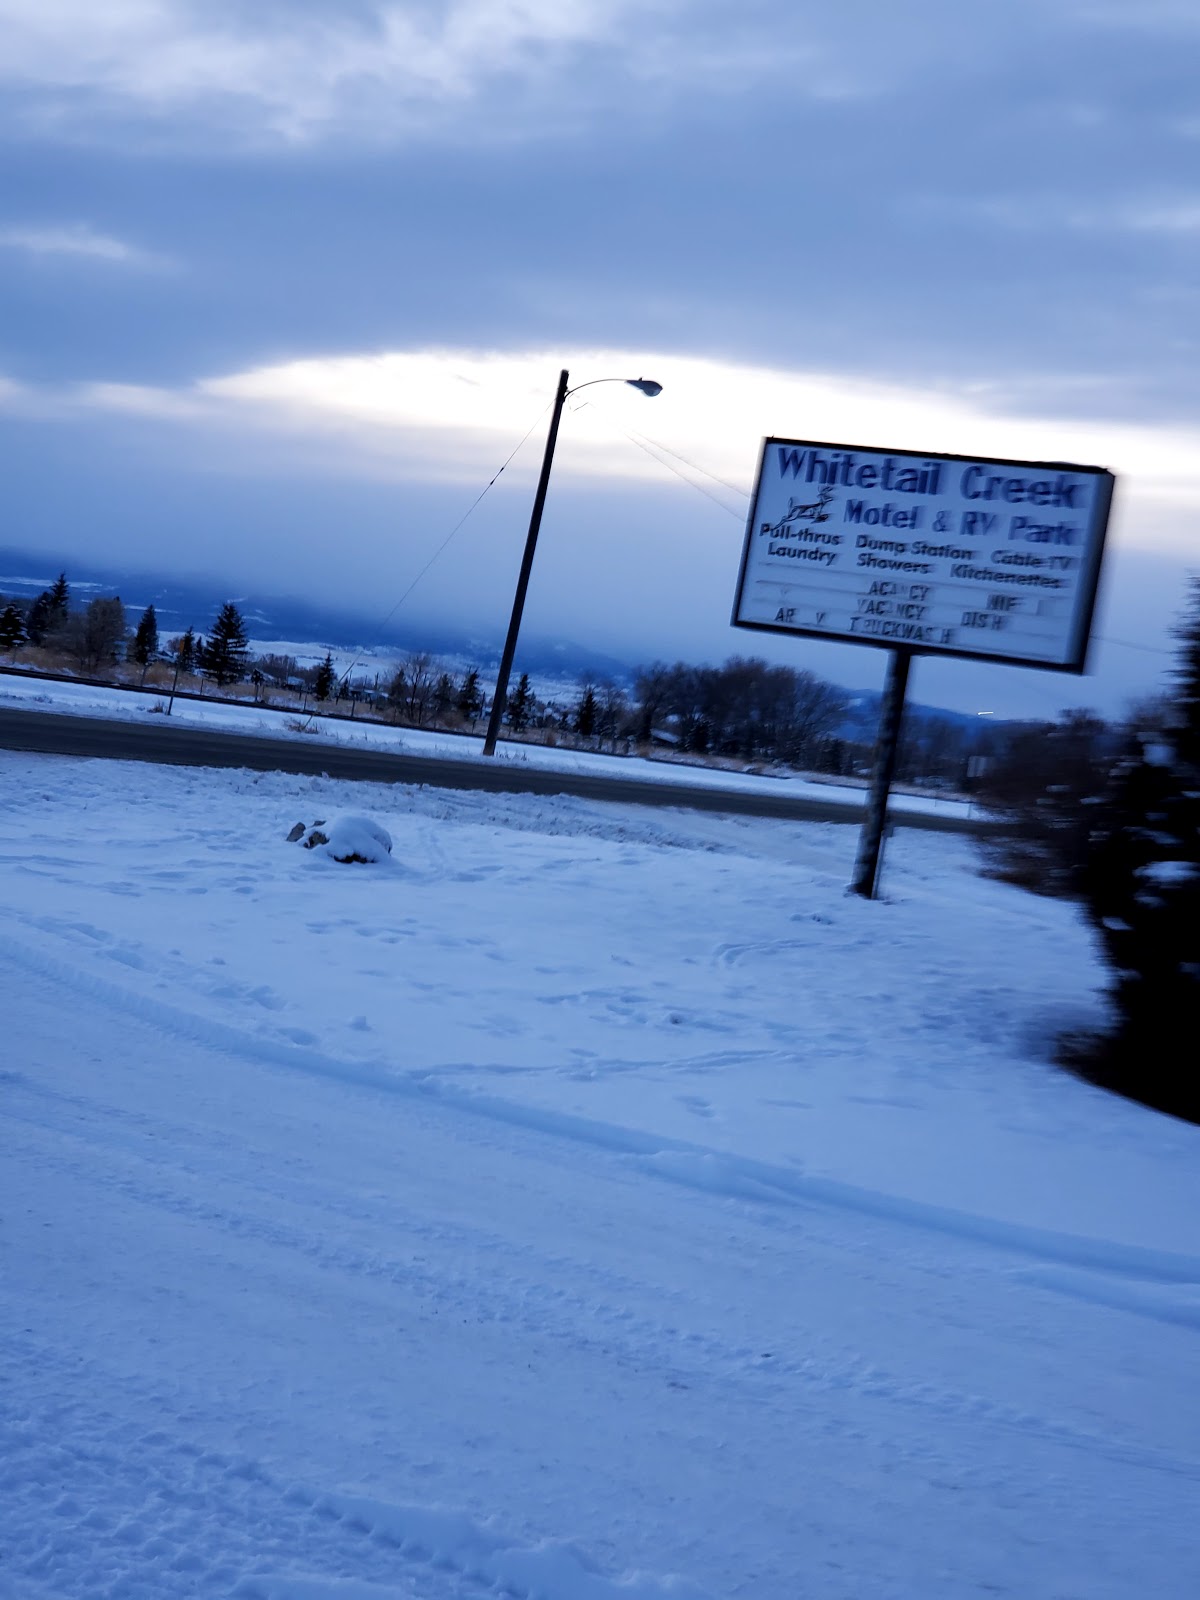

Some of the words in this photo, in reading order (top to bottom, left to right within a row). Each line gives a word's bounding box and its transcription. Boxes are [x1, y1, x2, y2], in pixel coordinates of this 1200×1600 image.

[777, 447, 942, 495] Whitetail
[959, 465, 1086, 509] Creek
[759, 523, 843, 546] Pull-thrus
[855, 534, 905, 555] Dump
[911, 540, 974, 560] Station
[990, 549, 1043, 568] Cable
[844, 499, 923, 530] Motel
[932, 510, 950, 533] &
[959, 510, 996, 536] RV
[1008, 516, 1079, 546] Park
[767, 542, 836, 566] Laundry
[856, 552, 931, 575] Showers
[950, 563, 1066, 589] Kitchenettes
